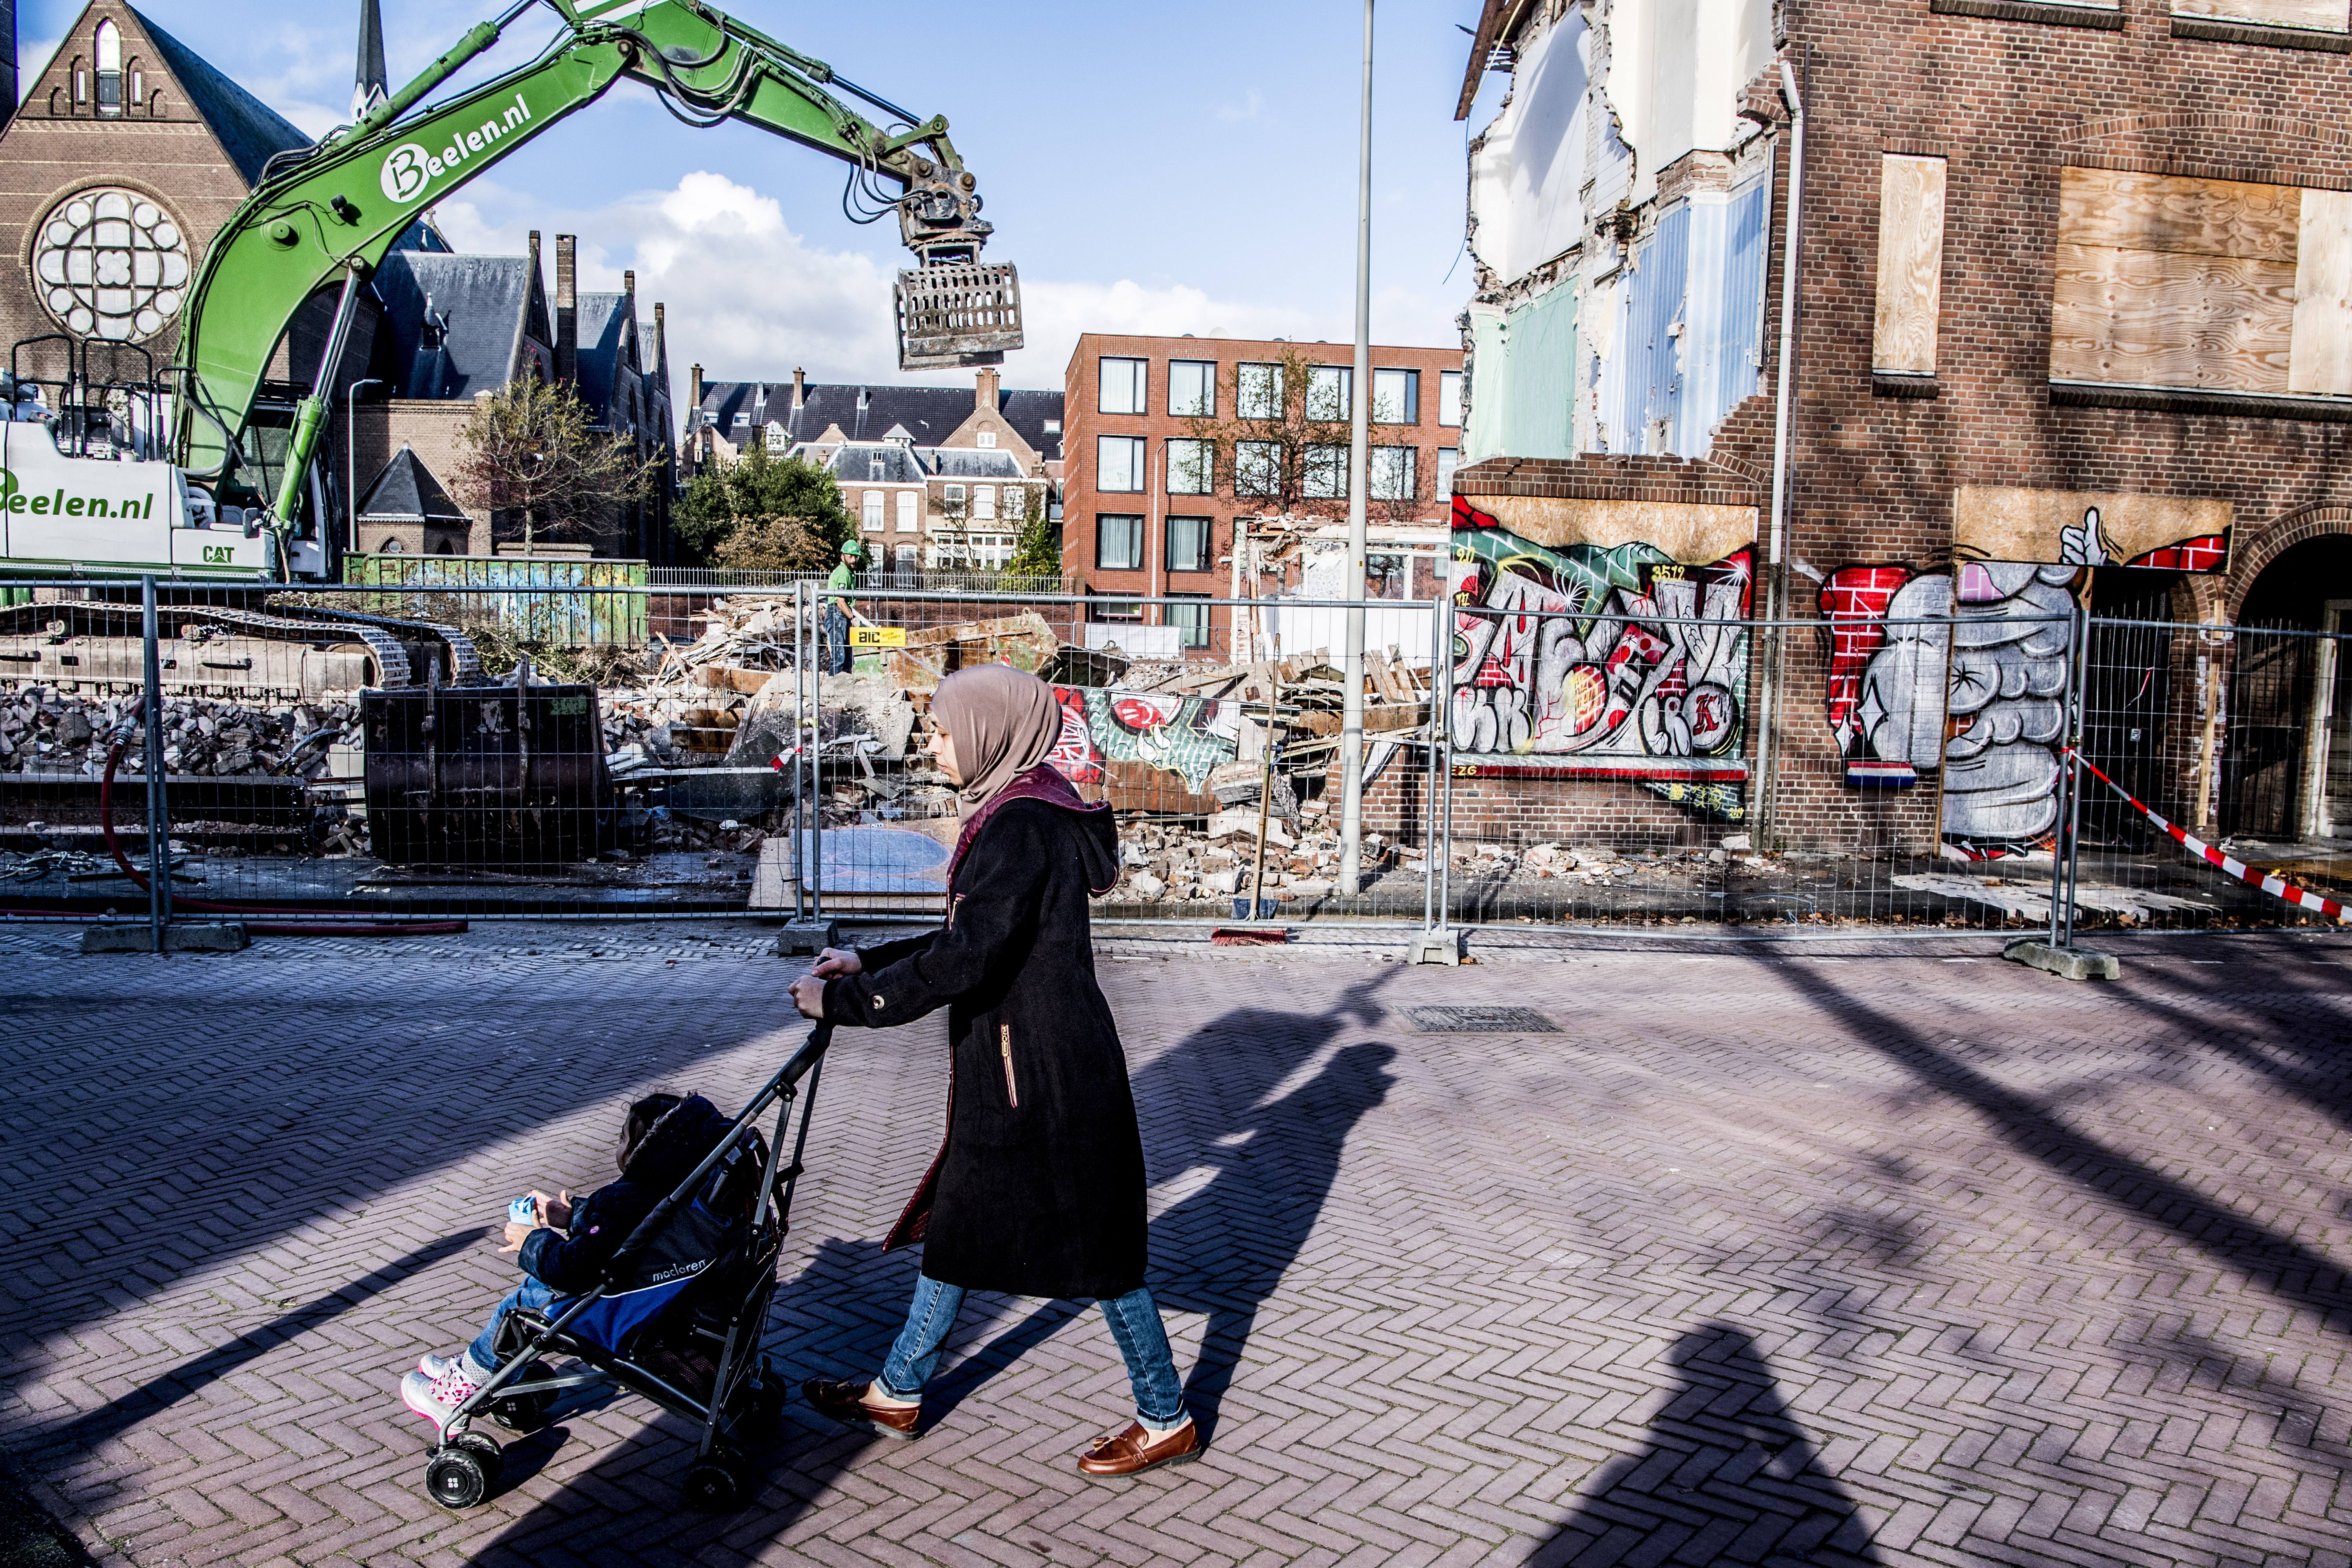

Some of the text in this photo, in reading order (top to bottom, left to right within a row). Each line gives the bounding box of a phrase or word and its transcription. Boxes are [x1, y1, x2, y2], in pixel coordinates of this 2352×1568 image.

[381, 93, 531, 203] Beelen.nl
[203, 546, 234, 563] CAT
[1456, 546, 1475, 564] 20
[1651, 564, 1685, 582] 3512
[776, 1116, 786, 1136] QUEST
[653, 1259, 706, 1282] maclaren
